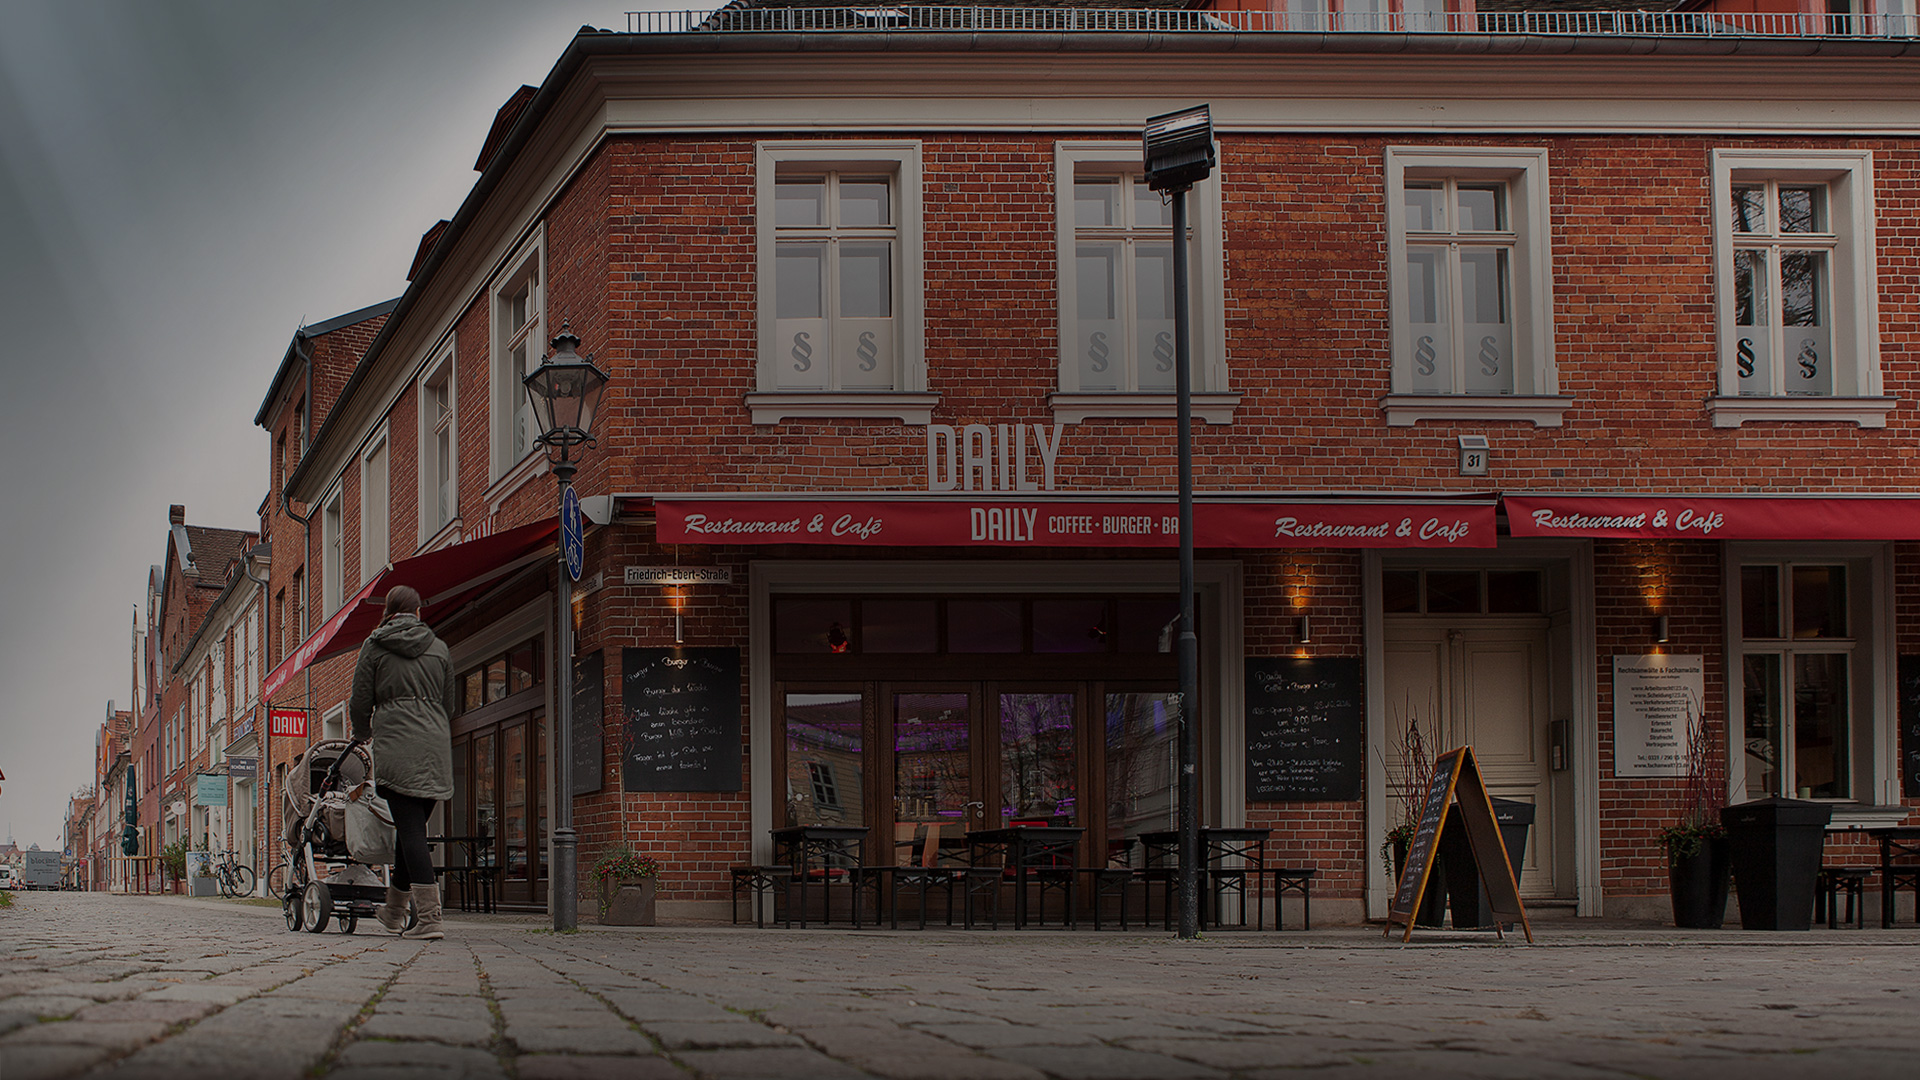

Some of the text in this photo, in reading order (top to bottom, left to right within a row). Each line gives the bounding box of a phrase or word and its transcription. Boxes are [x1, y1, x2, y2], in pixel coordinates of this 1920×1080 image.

[927, 423, 1064, 491] DAILY
[1468, 455, 1480, 467] 31
[684, 514, 883, 540] Restaurant & Café
[970, 507, 1179, 541] DAILY COFFEE BURGER BA
[1275, 517, 1470, 543] Restaurant & Café
[1531, 509, 1725, 534] Restaurant & Café
[627, 569, 729, 580] Friedrich-Ebert-Straße
[273, 716, 306, 735] DAILY
